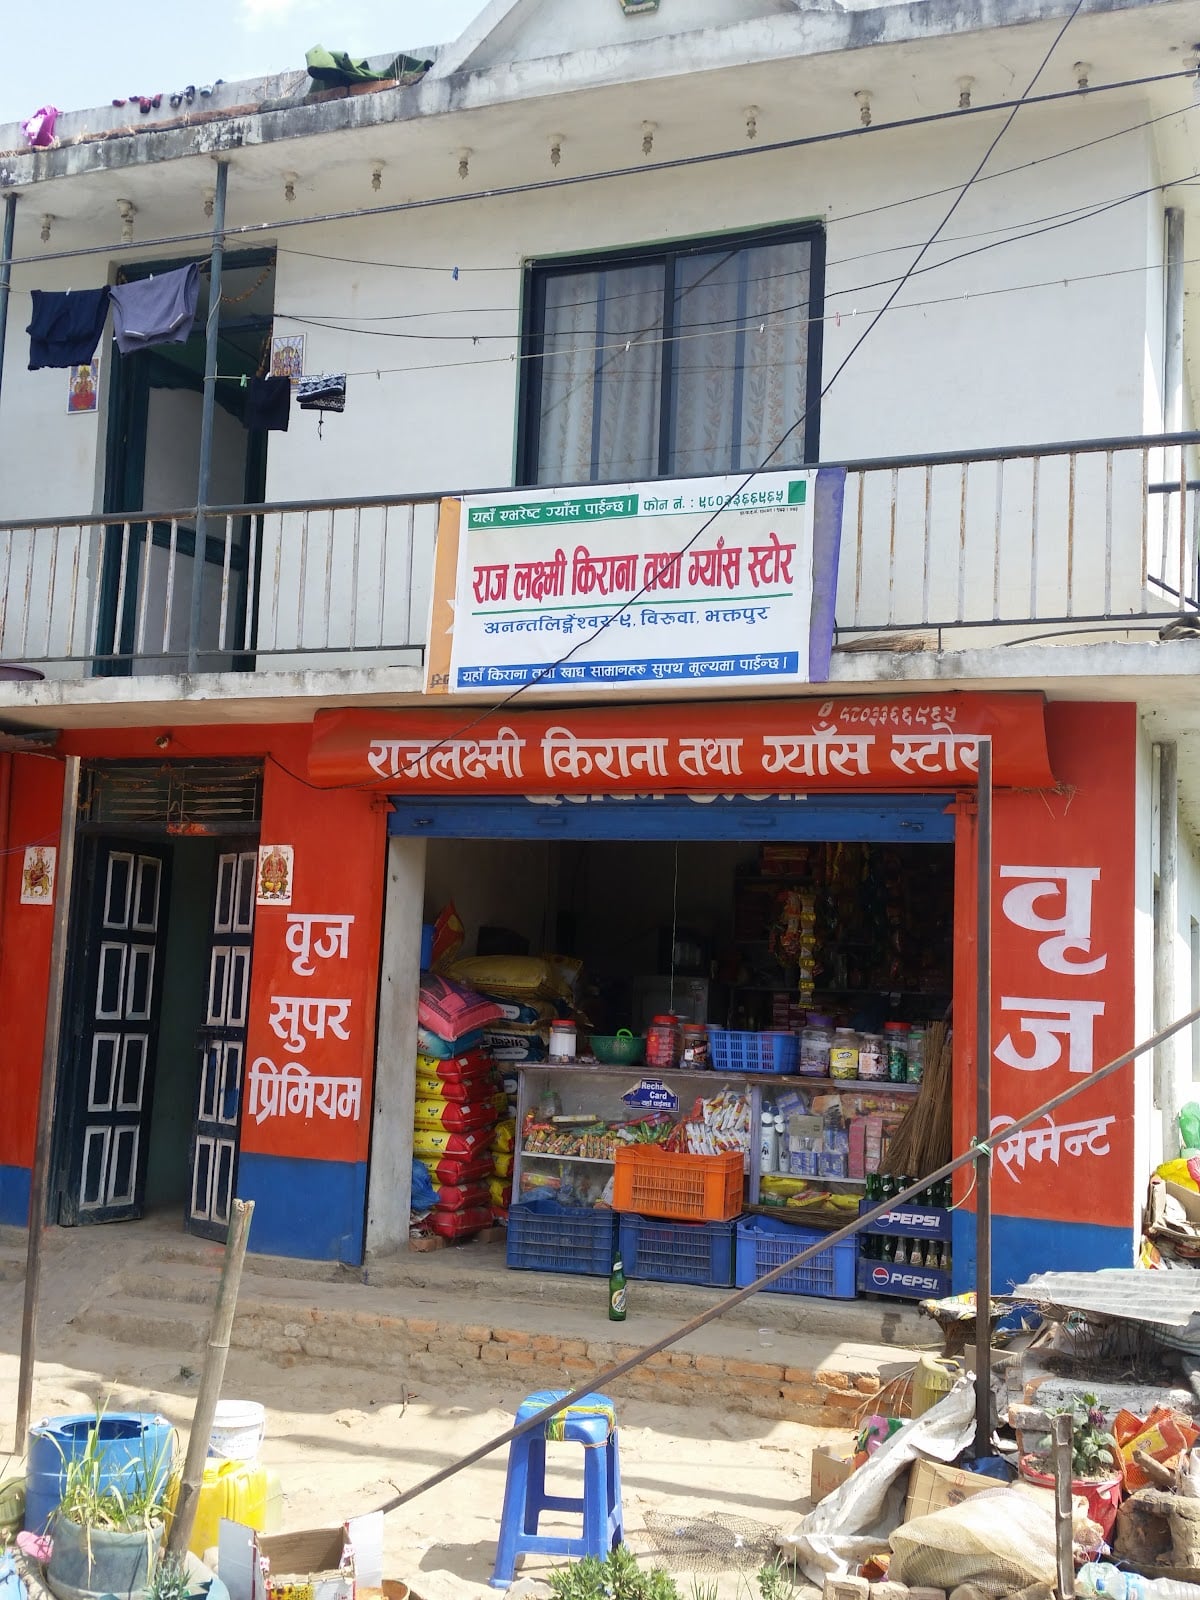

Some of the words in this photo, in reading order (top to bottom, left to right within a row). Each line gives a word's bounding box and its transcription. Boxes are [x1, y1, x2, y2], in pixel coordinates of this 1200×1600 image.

[643, 496, 669, 511] फोन
[472, 508, 496, 523] यहाँ
[473, 564, 510, 604] राज
[513, 548, 568, 603] लक्ष्मी
[571, 545, 639, 596] किराना
[643, 552, 684, 593] तथा
[688, 535, 743, 590] ग्याँस
[748, 532, 797, 588] स्टोर
[704, 606, 771, 626] भक्तपुर
[463, 667, 486, 682] यहाँ
[488, 667, 528, 681] किराना
[532, 667, 556, 680] तथा
[652, 662, 685, 679] सुपथ
[689, 660, 734, 676] मूल्यमा
[540, 726, 669, 779] किराना
[678, 738, 743, 776] तथा
[762, 721, 875, 777] ग्याँस
[890, 722, 992, 775] स्टोर
[285, 913, 355, 976] वृज
[269, 996, 352, 1053] सुपर
[249, 1057, 362, 1126] प्रिमियम
[649, 1091, 667, 1099] Card
[888, 1211, 940, 1228] PEPSI
[890, 1272, 938, 1290] PEPSI
